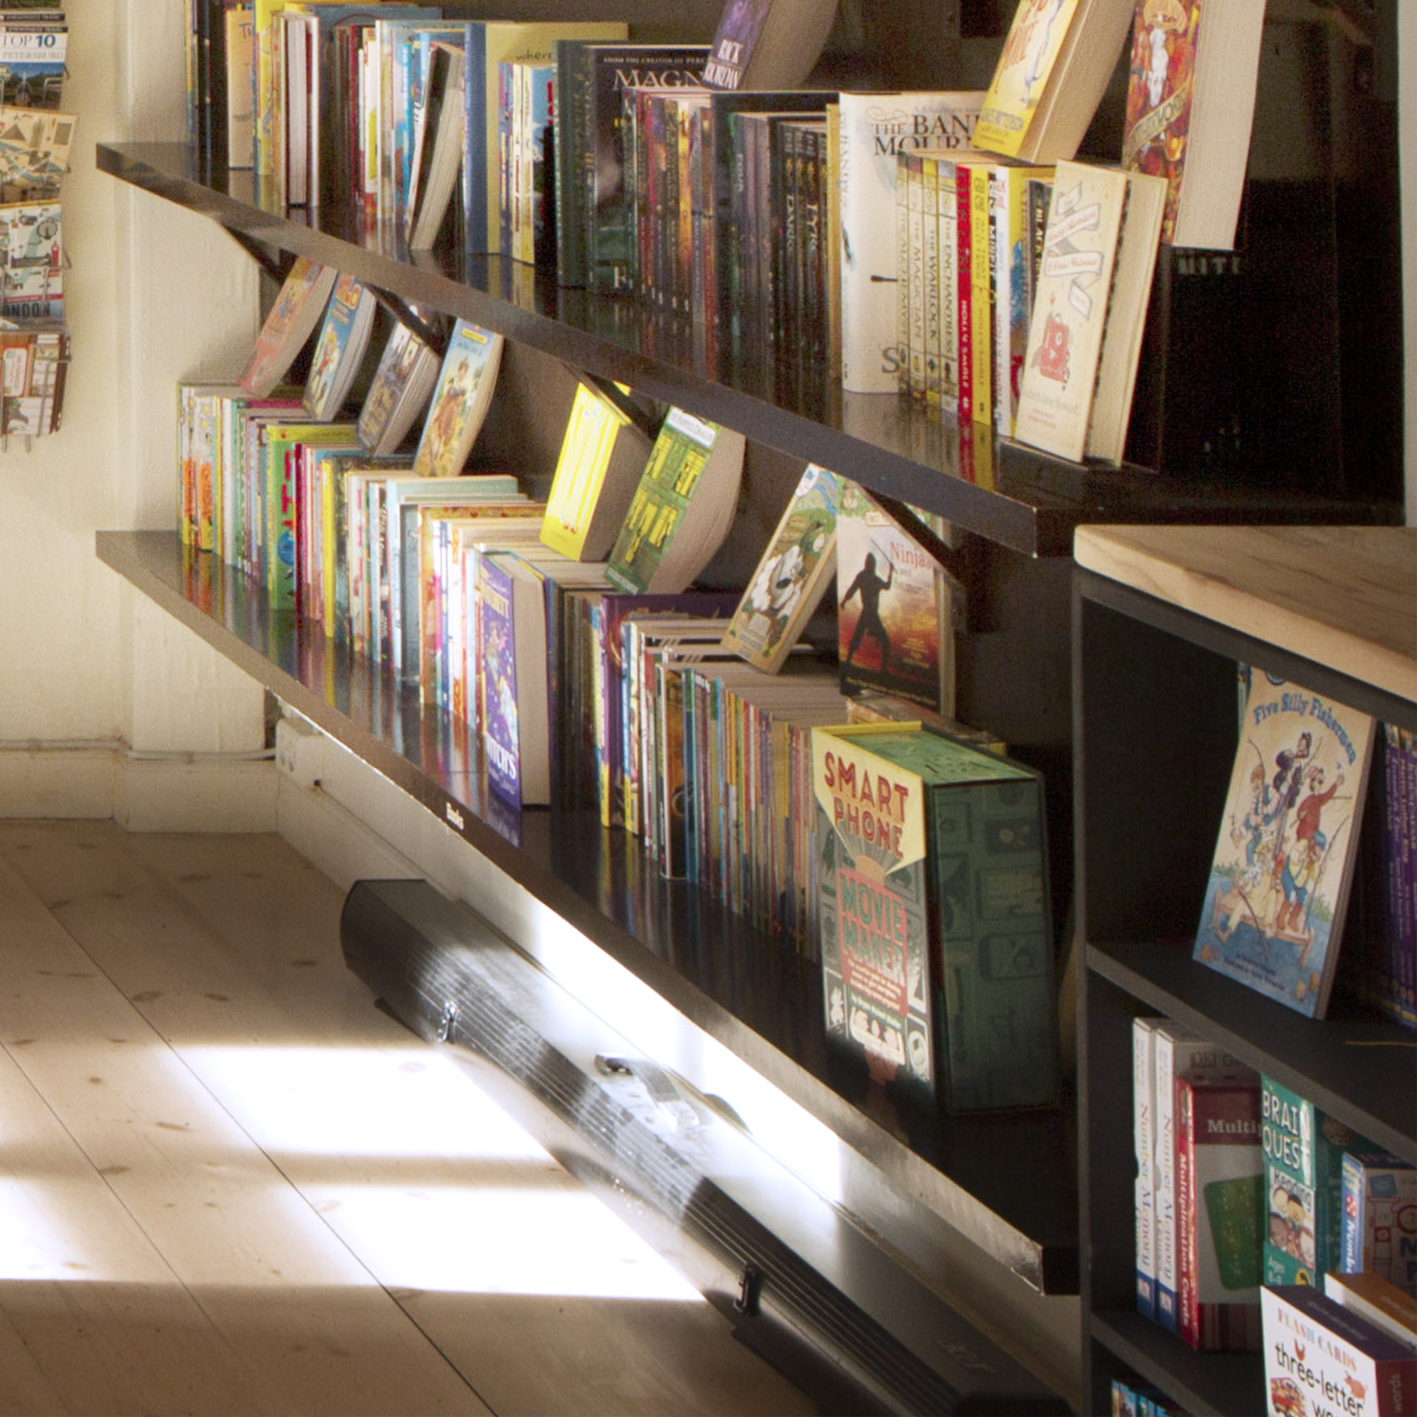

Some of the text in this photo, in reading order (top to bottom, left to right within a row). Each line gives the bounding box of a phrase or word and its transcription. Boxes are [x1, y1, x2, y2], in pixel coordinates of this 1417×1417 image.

[823, 750, 909, 825] SMART
[833, 795, 904, 859] PHONE
[839, 869, 905, 943] MOVIE
[842, 913, 906, 988] MAKER
